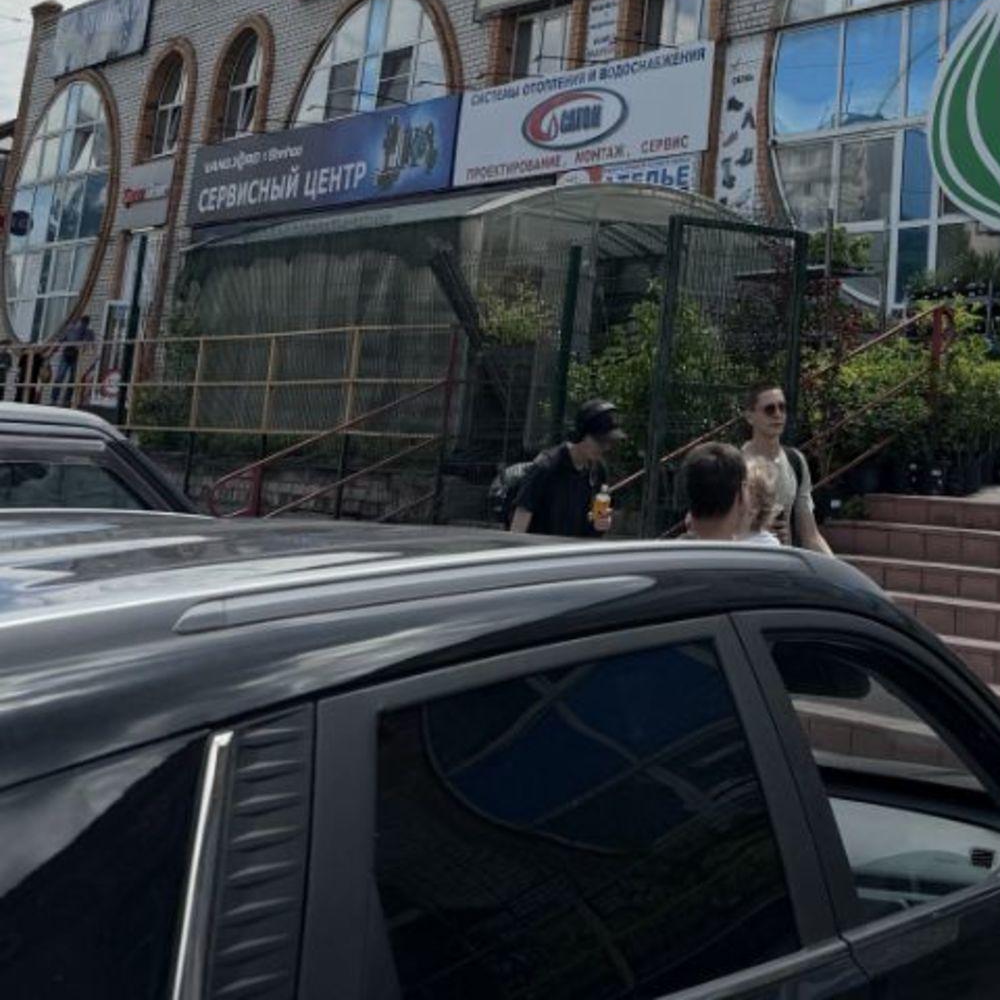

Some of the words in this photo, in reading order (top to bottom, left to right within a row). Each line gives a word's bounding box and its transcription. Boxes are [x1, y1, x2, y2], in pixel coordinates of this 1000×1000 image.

[641, 134, 690, 153] СЕРВИС
[198, 164, 300, 212] СЕРВИСНЫЙ
[303, 161, 367, 201] ЦЕНТР
